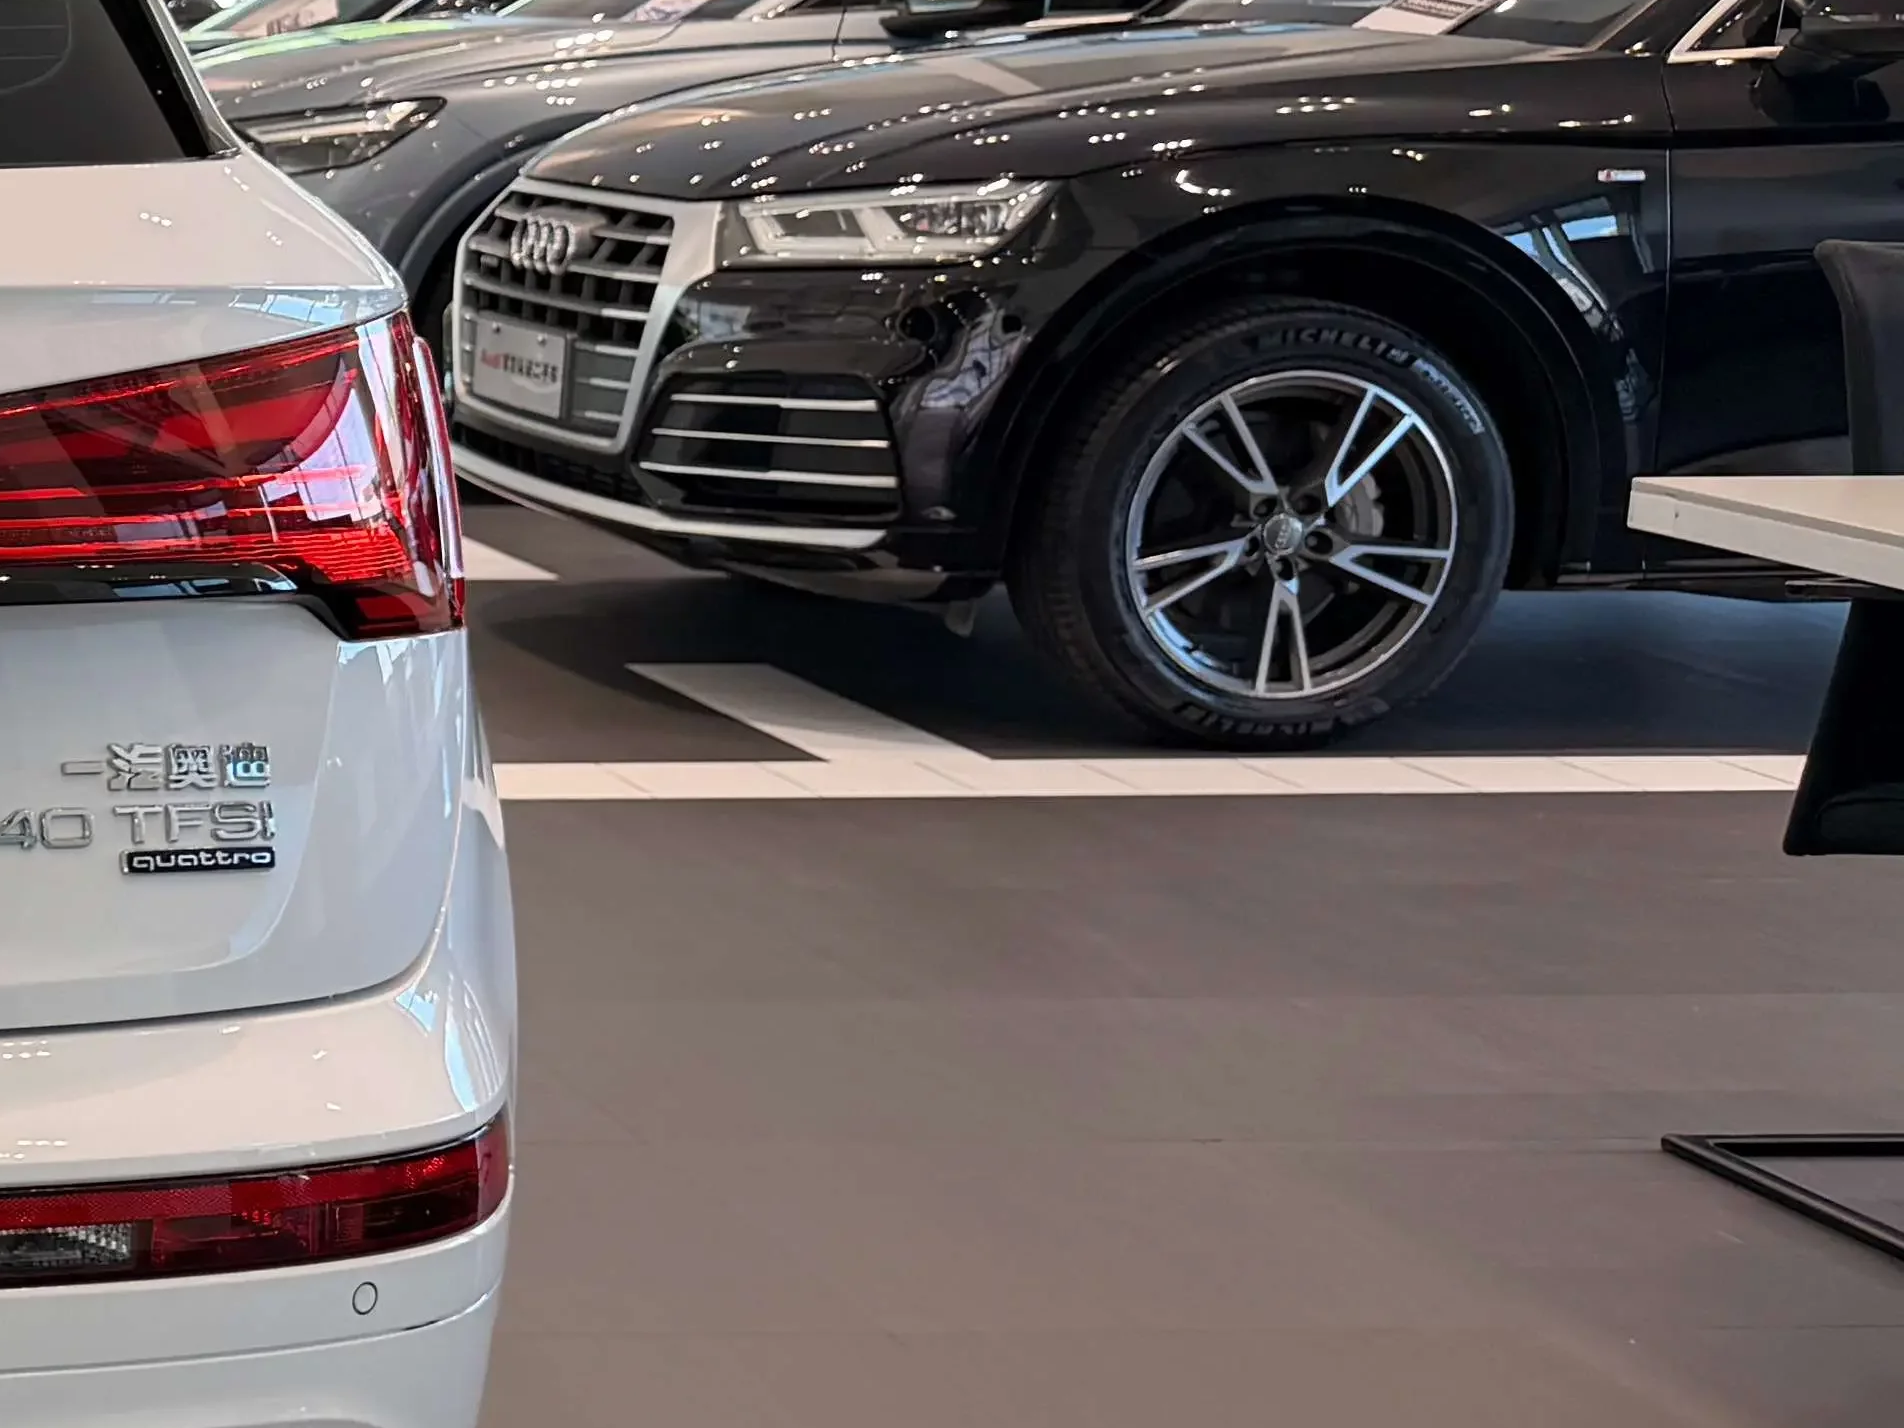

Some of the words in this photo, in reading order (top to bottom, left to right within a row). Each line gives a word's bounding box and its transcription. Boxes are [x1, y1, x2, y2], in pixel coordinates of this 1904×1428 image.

[60, 742, 272, 791] 一汽奥迪
[113, 800, 276, 844] TFSI
[131, 849, 272, 872] quattro
